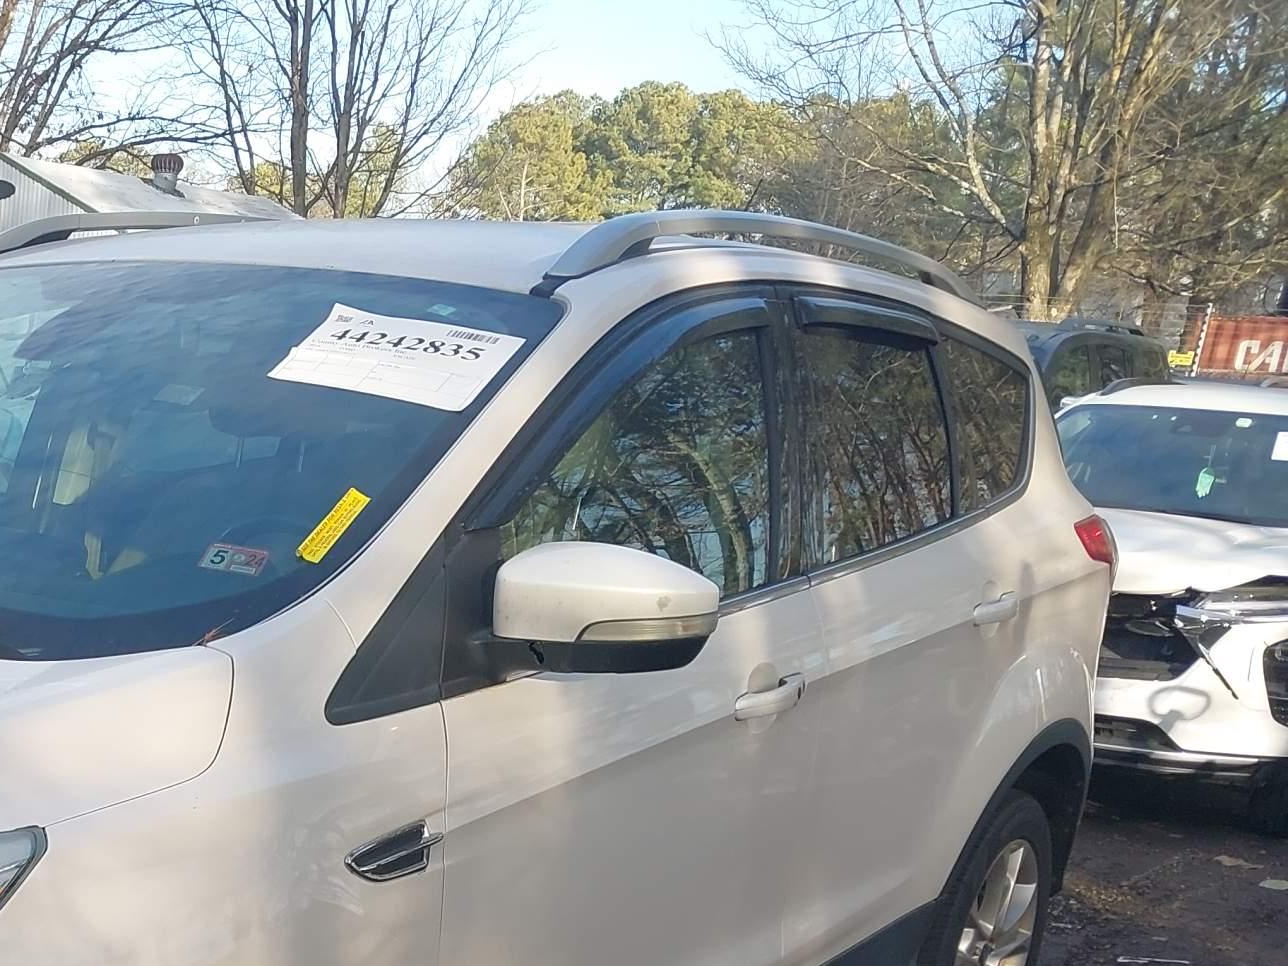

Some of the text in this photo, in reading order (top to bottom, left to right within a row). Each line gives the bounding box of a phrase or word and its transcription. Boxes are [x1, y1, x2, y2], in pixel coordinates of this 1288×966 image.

[329, 328, 486, 361] 44242835
[1234, 339, 1288, 373] CA
[209, 549, 229, 565] 5
